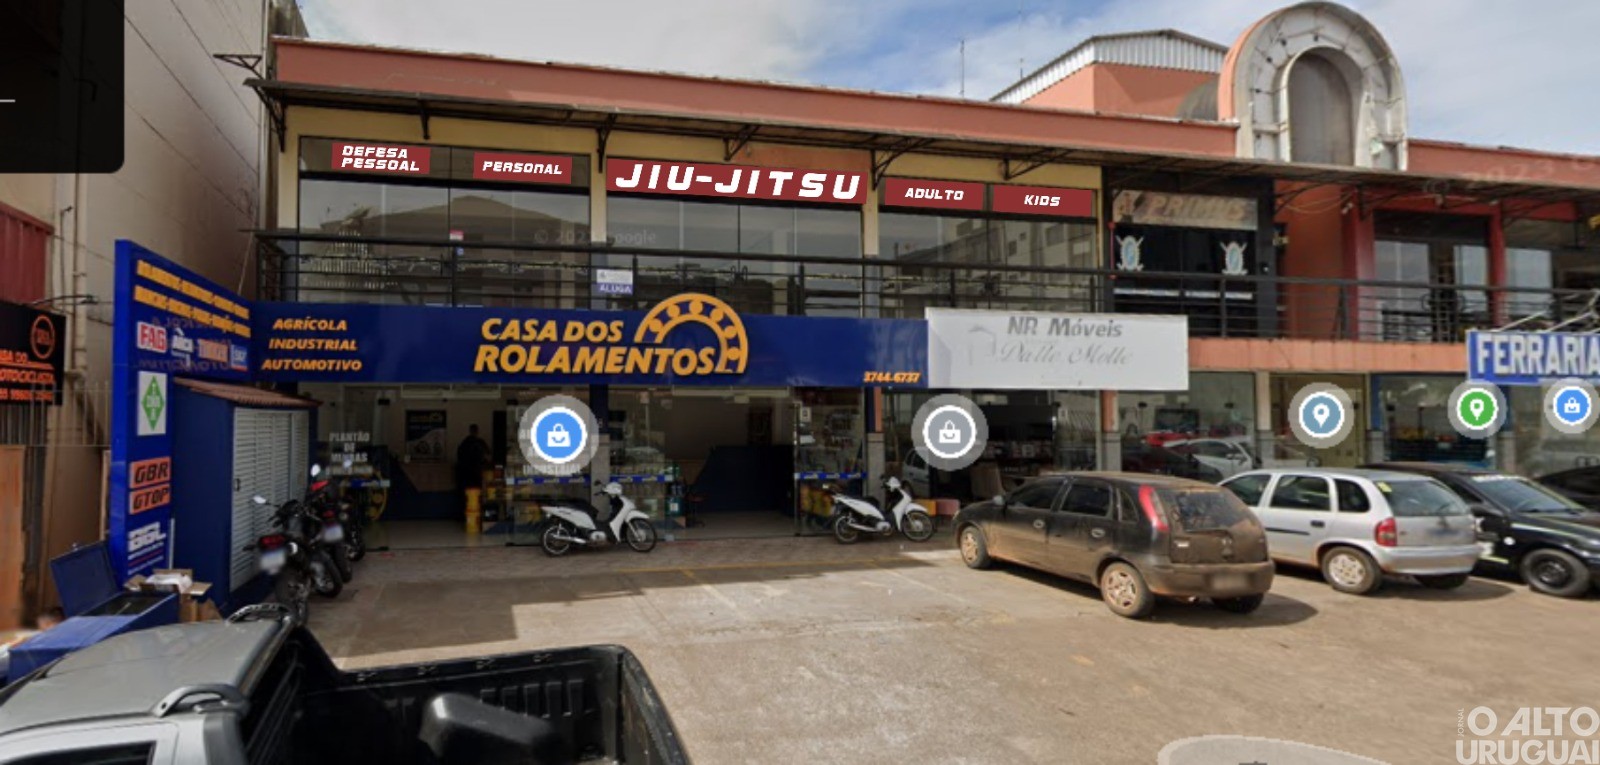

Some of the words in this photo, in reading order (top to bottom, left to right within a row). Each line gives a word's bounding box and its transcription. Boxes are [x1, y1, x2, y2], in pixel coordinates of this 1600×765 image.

[342, 145, 408, 159] DEFESA
[341, 157, 420, 172] PESSOAL
[482, 160, 563, 175] PERSONAL
[615, 163, 861, 200] JIU-JITSU
[904, 187, 964, 201] ADULTO
[1024, 194, 1061, 207] KIDS
[272, 316, 348, 331] AGRÍCOLA
[481, 318, 558, 342] CASA
[562, 320, 624, 343] DOS
[1007, 316, 1039, 336] NR
[1047, 317, 1124, 338] Móveis
[140, 324, 167, 351] FAG
[268, 338, 359, 351] INDUSTRIAL
[474, 345, 716, 376] ROLAMENTOS
[1477, 334, 1600, 375] FERRARIA
[261, 358, 363, 371] AUTOMOTIVO
[135, 461, 169, 484] GBR
[133, 487, 169, 510] GTOP
